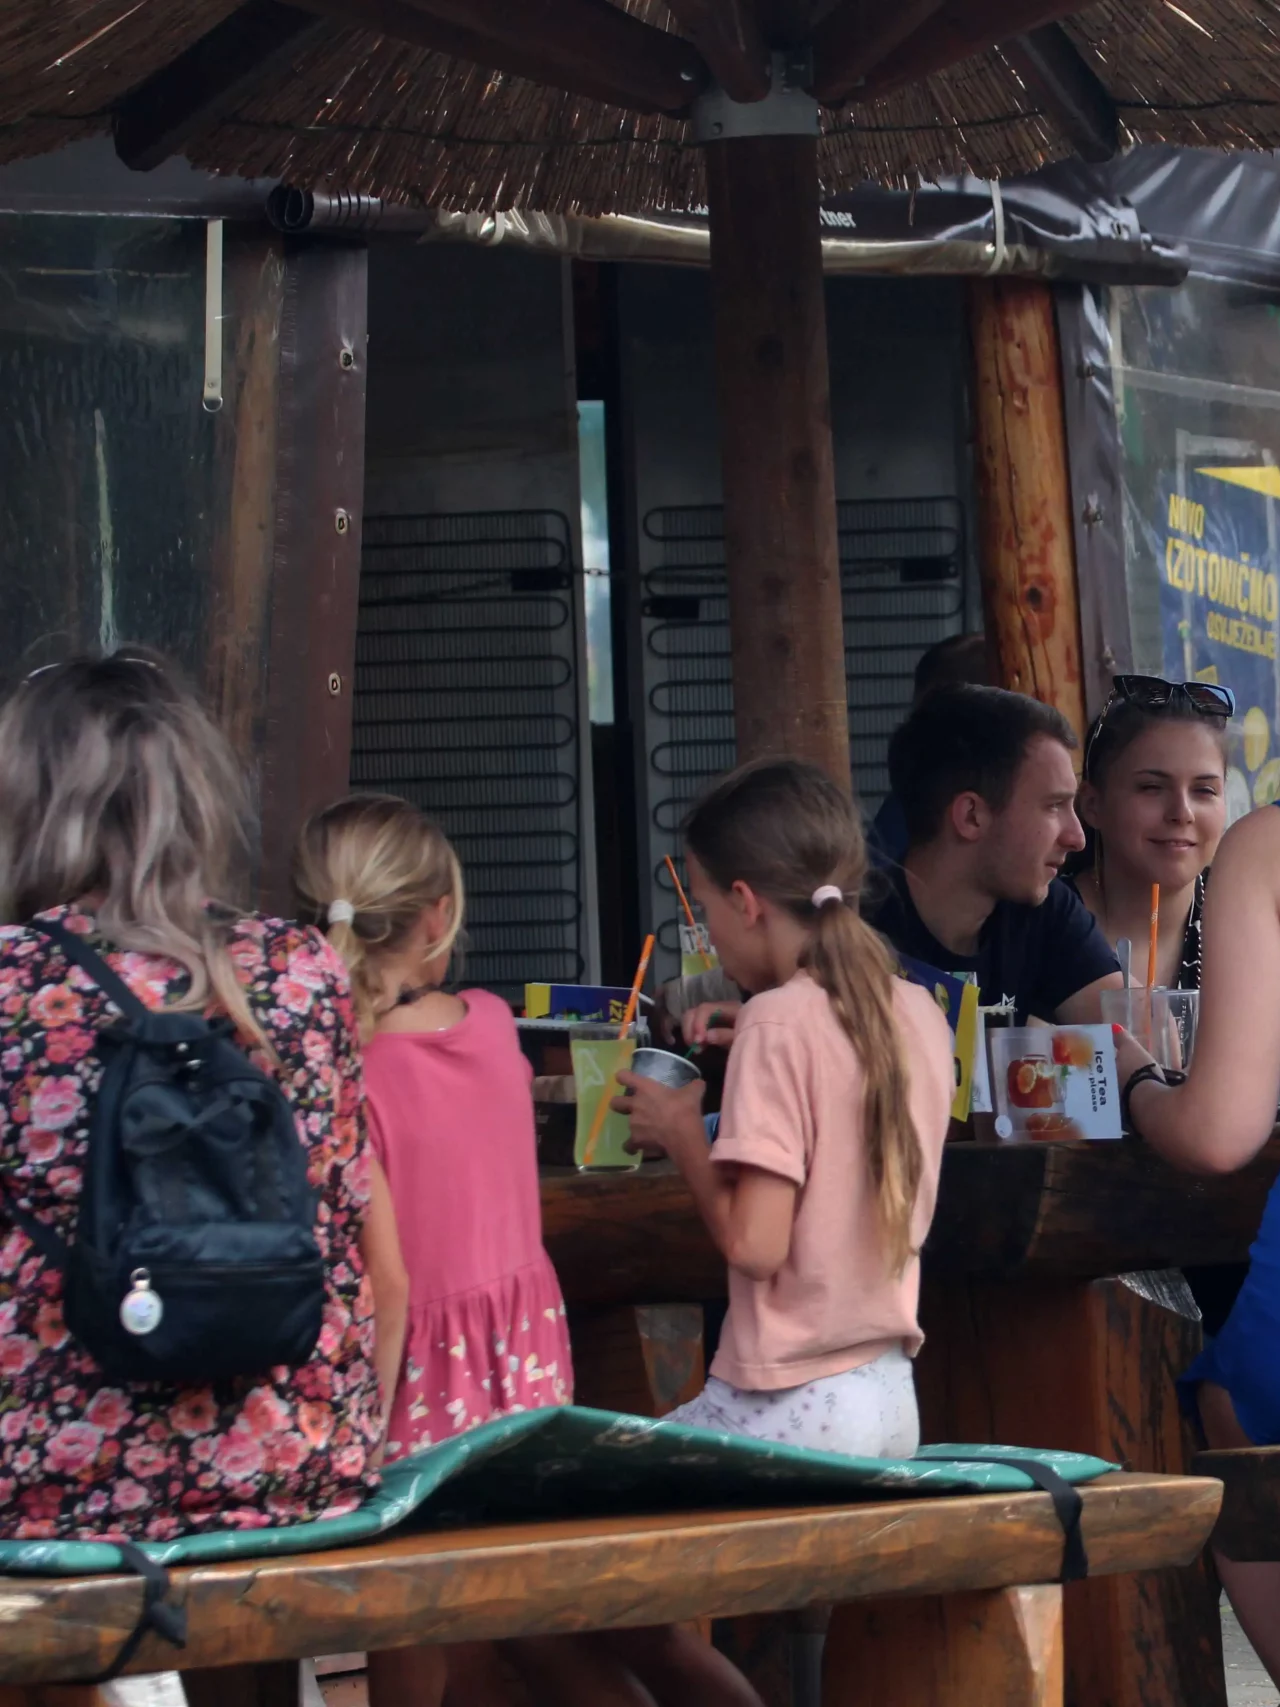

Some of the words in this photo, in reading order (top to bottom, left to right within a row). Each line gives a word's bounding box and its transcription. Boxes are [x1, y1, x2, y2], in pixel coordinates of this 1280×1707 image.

[819, 205, 857, 228] tner
[1168, 493, 1205, 540] NOVO
[1165, 536, 1279, 622] IZOTONIČNO
[1095, 1050, 1104, 1074] Ice
[1088, 1077, 1098, 1113] please
[1097, 1077, 1107, 1106] Tea
